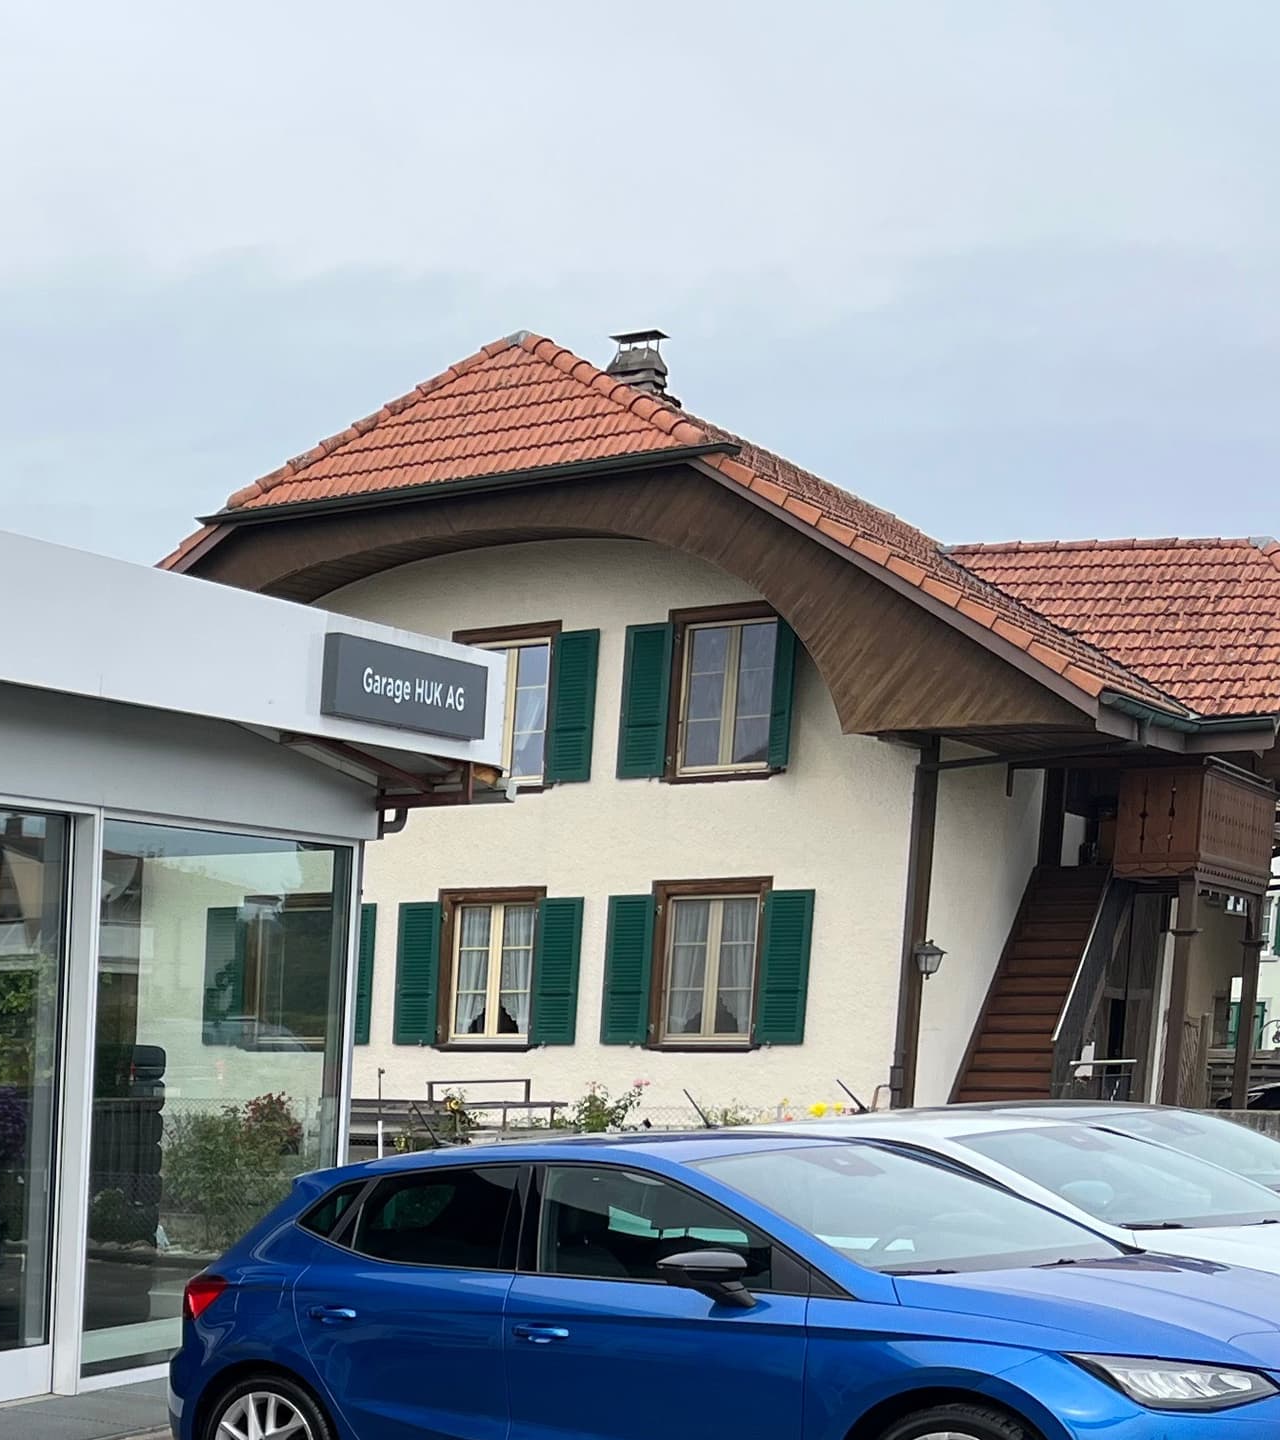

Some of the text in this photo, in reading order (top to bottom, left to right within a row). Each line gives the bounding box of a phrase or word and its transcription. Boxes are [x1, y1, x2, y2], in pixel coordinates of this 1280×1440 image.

[362, 667, 465, 711] Garage HUK AG
